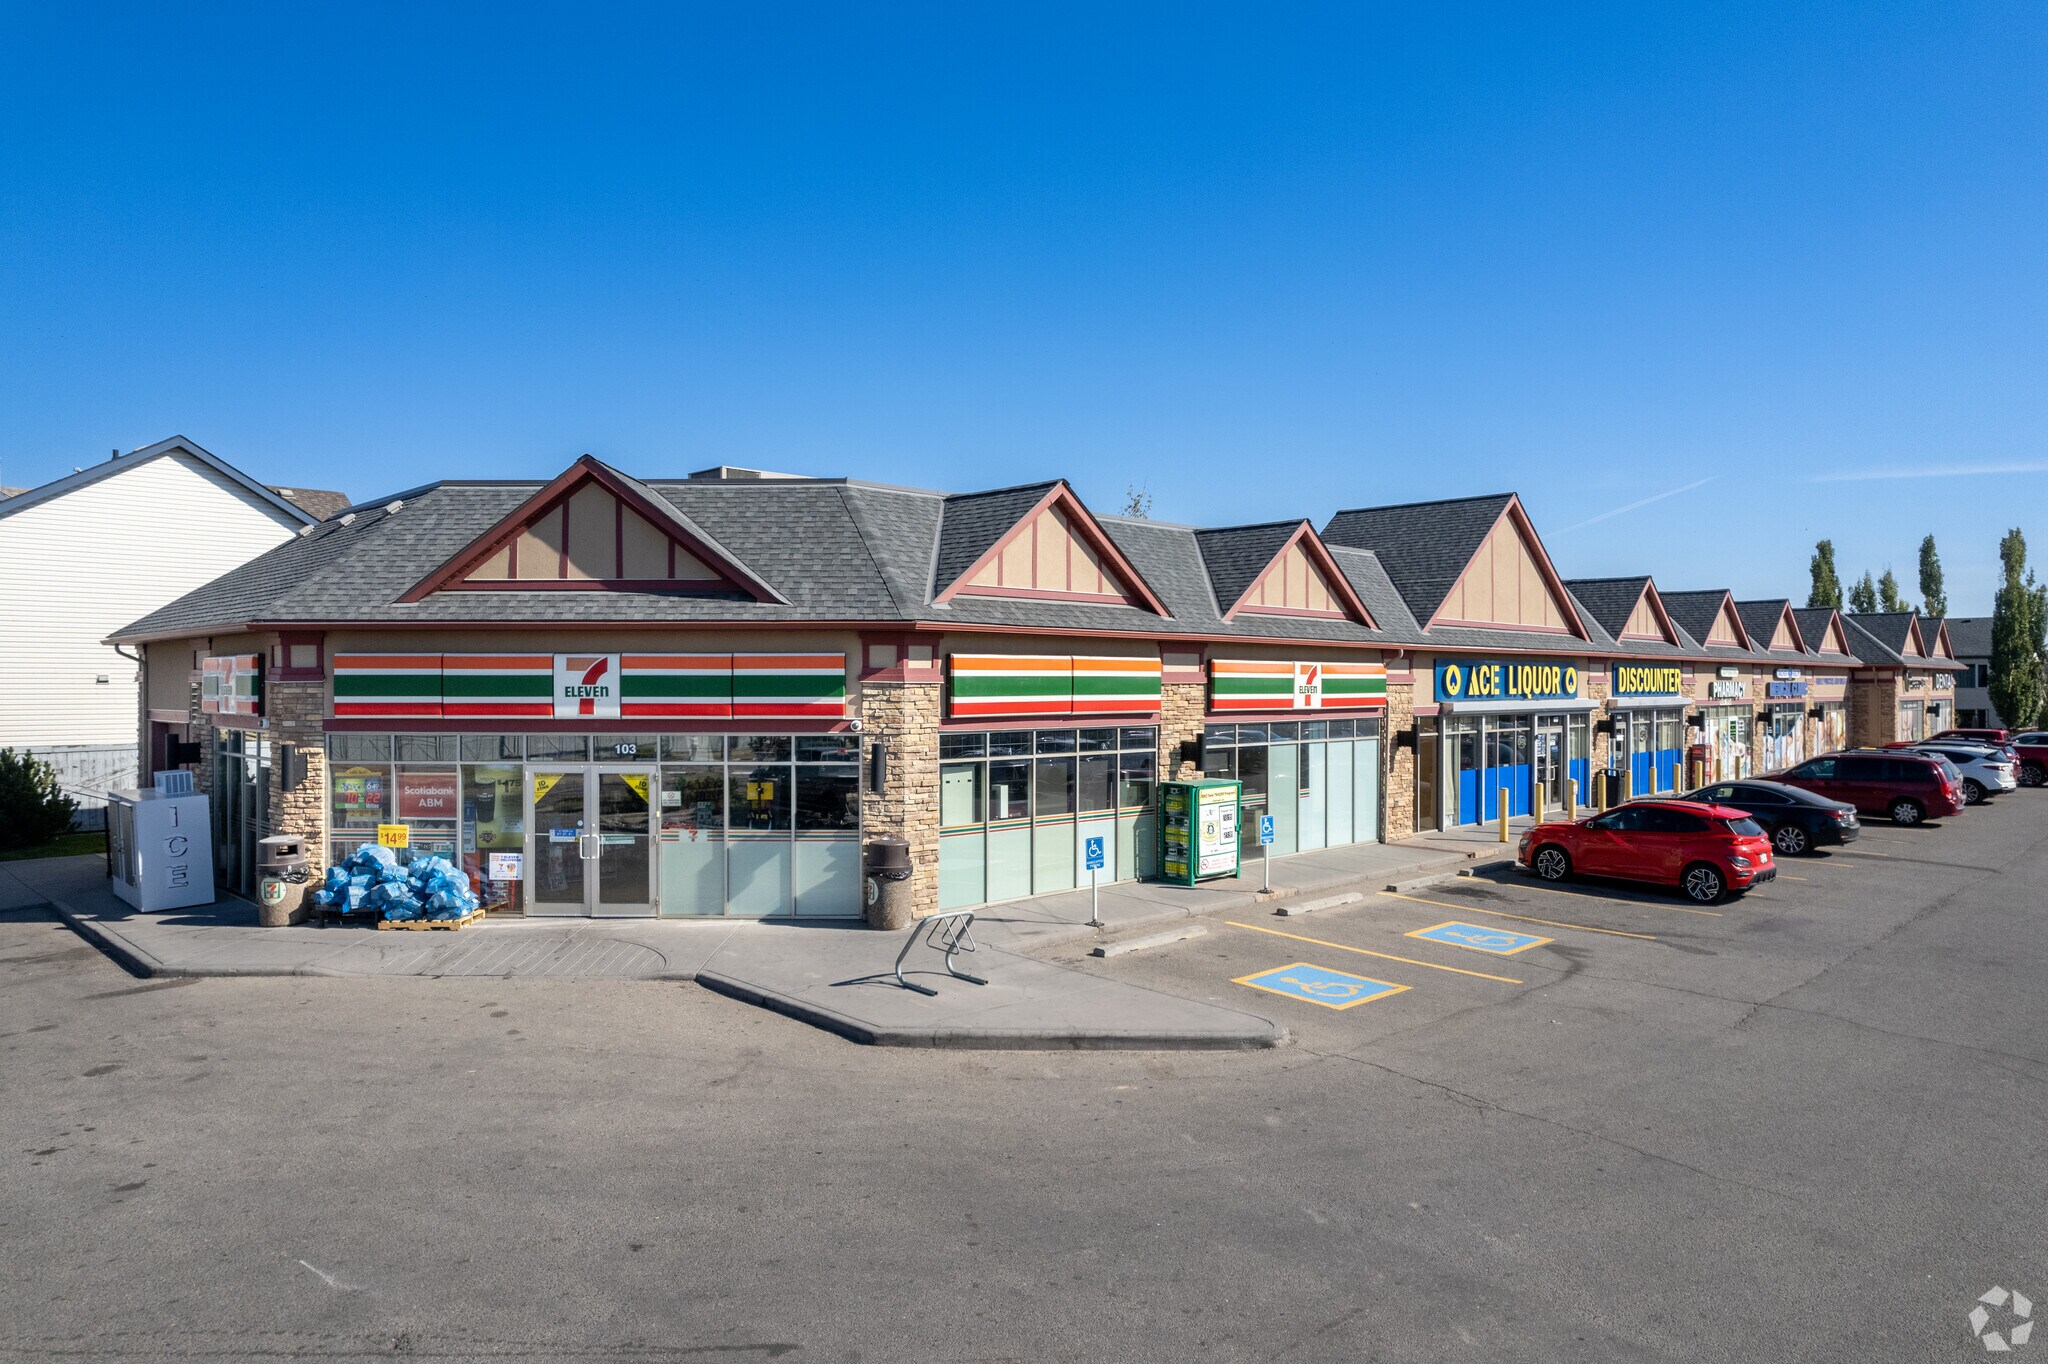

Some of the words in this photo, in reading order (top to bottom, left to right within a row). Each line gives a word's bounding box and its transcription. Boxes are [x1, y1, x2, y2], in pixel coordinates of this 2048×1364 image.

[1468, 665, 1500, 696] ACE
[1508, 665, 1561, 700] LIQUOR
[1618, 666, 1681, 693] DISCOUNTER
[1712, 681, 1746, 698] PHARMACY
[614, 744, 637, 755] 103
[365, 792, 381, 803] 22
[404, 785, 455, 796] Scotiabank
[418, 798, 443, 808] ABM
[164, 805, 189, 890] ICE
